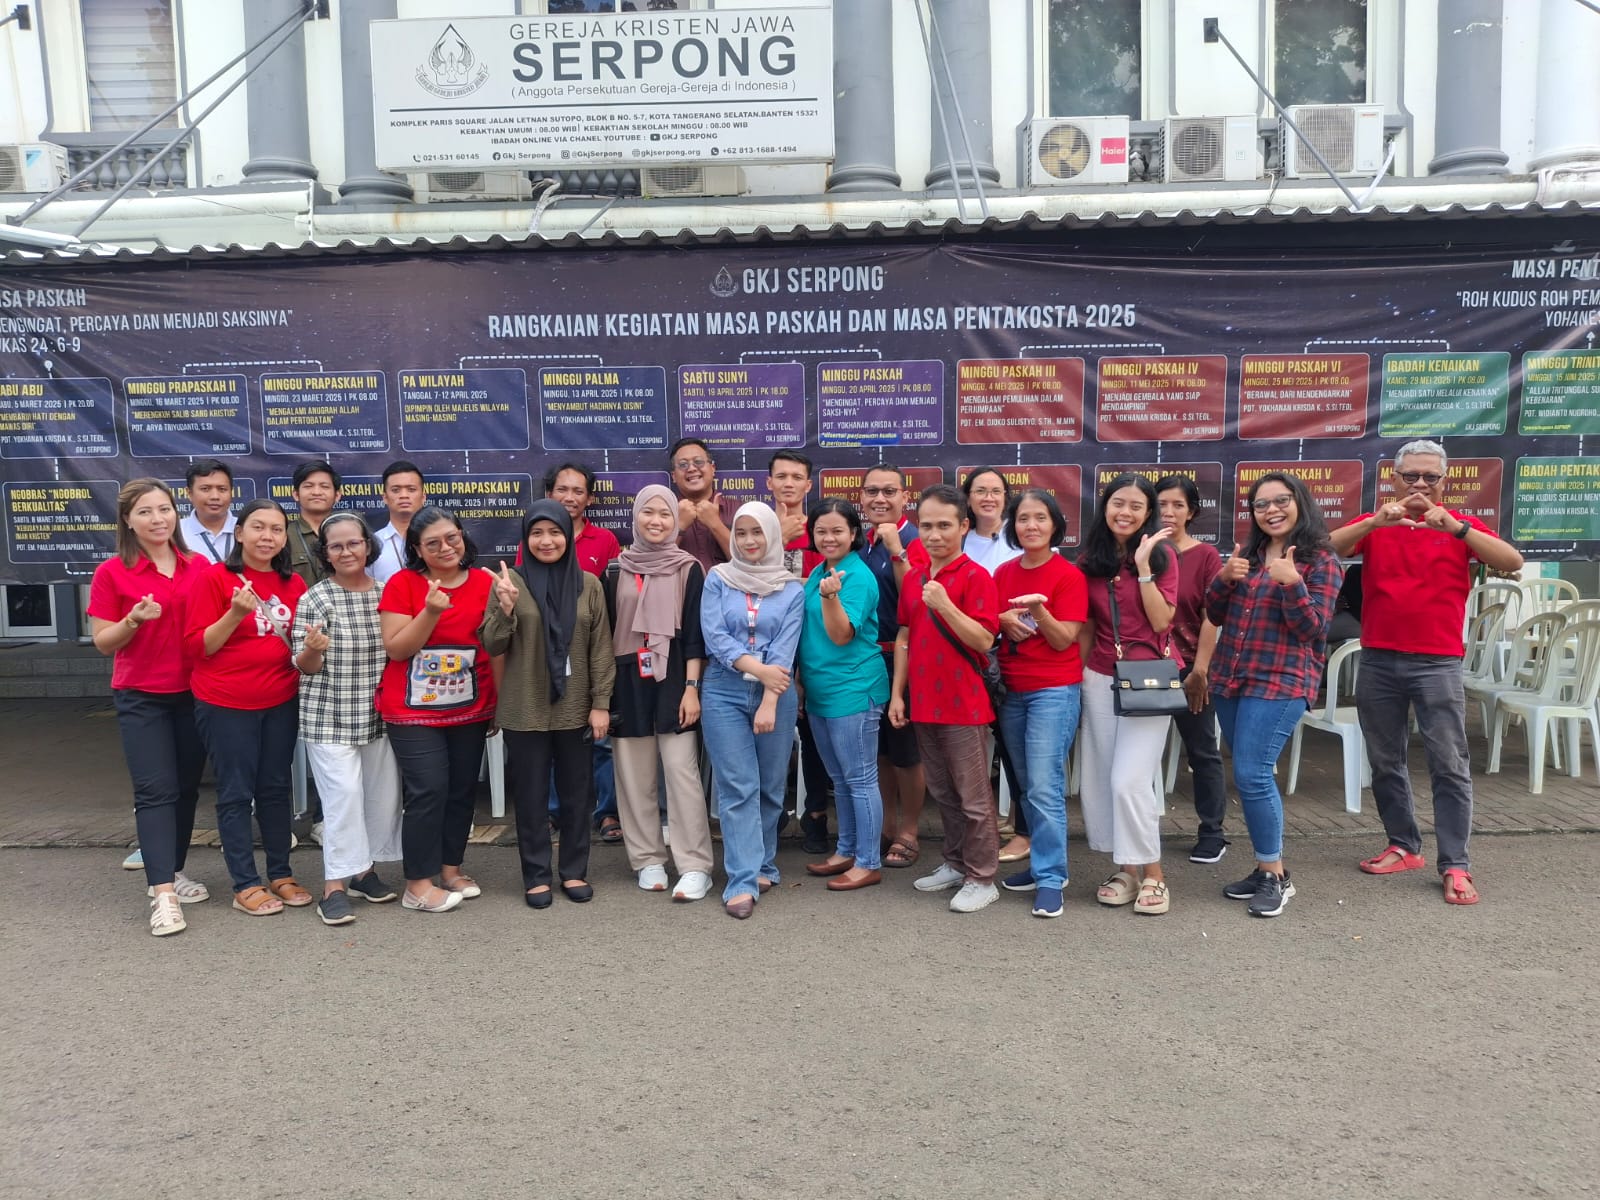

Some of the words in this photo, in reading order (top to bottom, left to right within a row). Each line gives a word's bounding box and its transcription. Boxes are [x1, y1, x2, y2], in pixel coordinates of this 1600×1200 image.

[510, 21, 604, 40] GEREJA
[615, 18, 718, 36] KRISTEN
[731, 16, 795, 33] JAWA
[512, 35, 795, 82] SERPONG
[567, 84, 636, 95] Persekutuan
[640, 82, 718, 95] Gereja-Gereja
[721, 81, 731, 91] di
[735, 80, 788, 91] Indonesia
[502, 152, 516, 160] Gkj
[518, 151, 551, 160] Serpong
[641, 148, 701, 157] gkjserpong.org
[1101, 147, 1125, 155] Haier
[1511, 259, 1555, 278] MASA
[742, 268, 780, 293] GKJ
[787, 266, 882, 293] SERPONG
[0, 290, 22, 308] SA
[27, 288, 87, 307] PASKAH
[1456, 290, 1488, 307] "ROH
[1493, 290, 1537, 307] KUDUS
[1540, 290, 1568, 307] ROH
[0, 316, 67, 333] ENGINGAT,
[70, 314, 130, 332] PERCAYA
[133, 313, 160, 330] DAN
[163, 311, 218, 329] MENJADI
[222, 309, 293, 328] SAKSINYA"
[488, 314, 598, 338] RANGKAIAN
[605, 312, 699, 337] KEGIATAN
[706, 311, 759, 335] MASA
[766, 309, 841, 334] PASKAH
[851, 308, 887, 332] DAN
[893, 307, 947, 331] MASA
[954, 304, 1079, 330] PENTAKOSTA
[1085, 303, 1136, 328] 2025
[0, 337, 27, 353] KAS
[30, 337, 48, 352] 24
[1102, 363, 1141, 376] MINGGU
[1145, 363, 1185, 375] PASKAH
[1188, 362, 1199, 375] IV
[1245, 361, 1284, 374] MINGGU
[1288, 361, 1328, 373] PASKAH
[1331, 360, 1341, 373] VI
[1387, 360, 1425, 373] IBADAH
[1428, 359, 1480, 372] KENAIKAN
[1527, 357, 1568, 369] MINGGU
[683, 371, 715, 384] SABTU
[718, 371, 748, 383] SUNYI
[822, 369, 860, 382] MINGGU
[863, 368, 903, 380] PASKAH
[961, 366, 999, 378] MINGGU
[1002, 365, 1042, 377] PASKAH
[1045, 365, 1056, 377] III
[264, 378, 302, 391] MINGGU
[305, 376, 363, 390] PRAPASKAH
[366, 376, 377, 388] III
[402, 375, 416, 388] PA
[418, 375, 465, 387] WILAYAH
[543, 373, 582, 386] MINGGU
[585, 373, 620, 385] PALMA
[22, 383, 43, 396] ABU
[127, 382, 165, 394] MINGGU
[168, 381, 225, 393] PRAPASKAH
[229, 380, 236, 392] II
[581, 389, 600, 397] APRIL
[601, 389, 618, 397] 2025
[624, 389, 634, 397] PK
[716, 387, 735, 395] APRIL
[736, 387, 753, 395] 2025
[859, 385, 877, 393] APRIL
[879, 384, 895, 393] 2025
[403, 391, 432, 400] TANGGAL
[434, 391, 449, 399] 7-12
[450, 391, 469, 399] APRIL
[470, 390, 488, 399] 2025
[1325, 468, 1332, 480] V
[1465, 466, 1479, 478] VII
[1519, 465, 1557, 477] IBADAH
[451, 482, 510, 494] PRAPASKAH
[513, 481, 520, 493] V
[722, 478, 755, 490] AGUNG
[823, 475, 861, 488] MINGGU
[10, 489, 47, 500] NGOBRAS
[48, 488, 92, 499] "NGOBROL
[12, 501, 69, 512] BERKUALITAS"
[460, 510, 493, 518] MERESPON
[495, 509, 515, 517] KASIH
